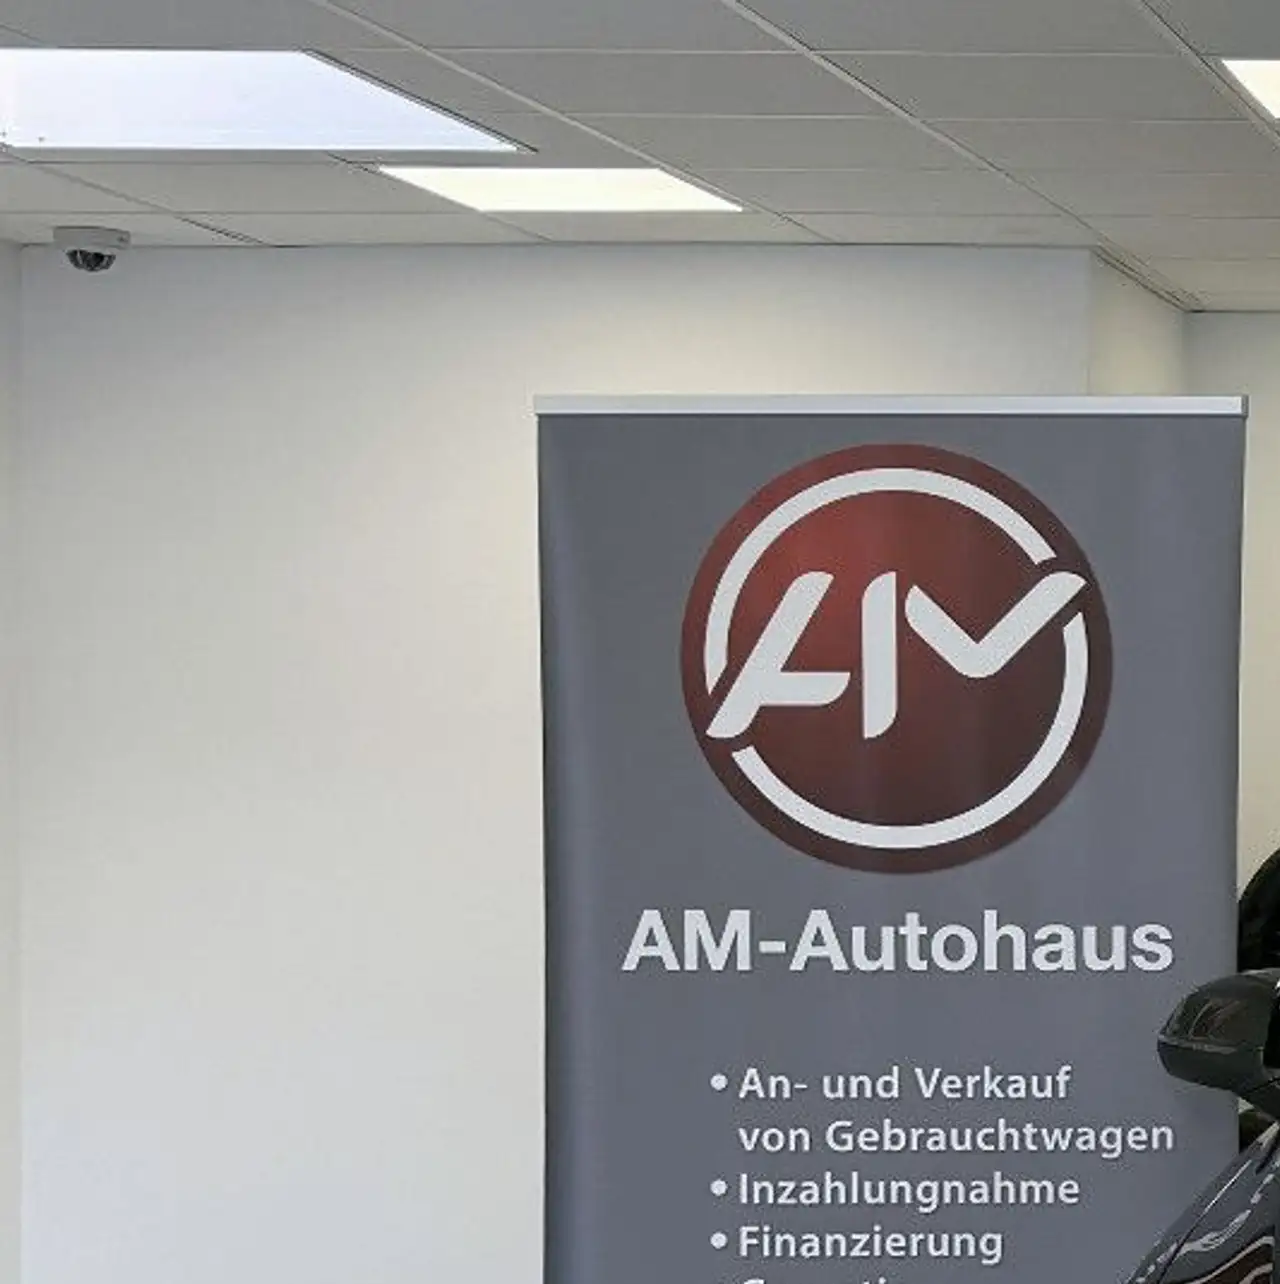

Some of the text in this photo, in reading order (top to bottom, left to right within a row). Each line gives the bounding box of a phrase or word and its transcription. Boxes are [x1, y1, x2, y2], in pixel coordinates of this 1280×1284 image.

[621, 908, 1174, 973] AM-Autohaus
[738, 1063, 1073, 1100] An- und Verkauf
[738, 1116, 1174, 1160] von Gebrauchtwagen
[738, 1170, 1081, 1214] Inzahlungnahme
[738, 1223, 1003, 1266] Finanzierung
